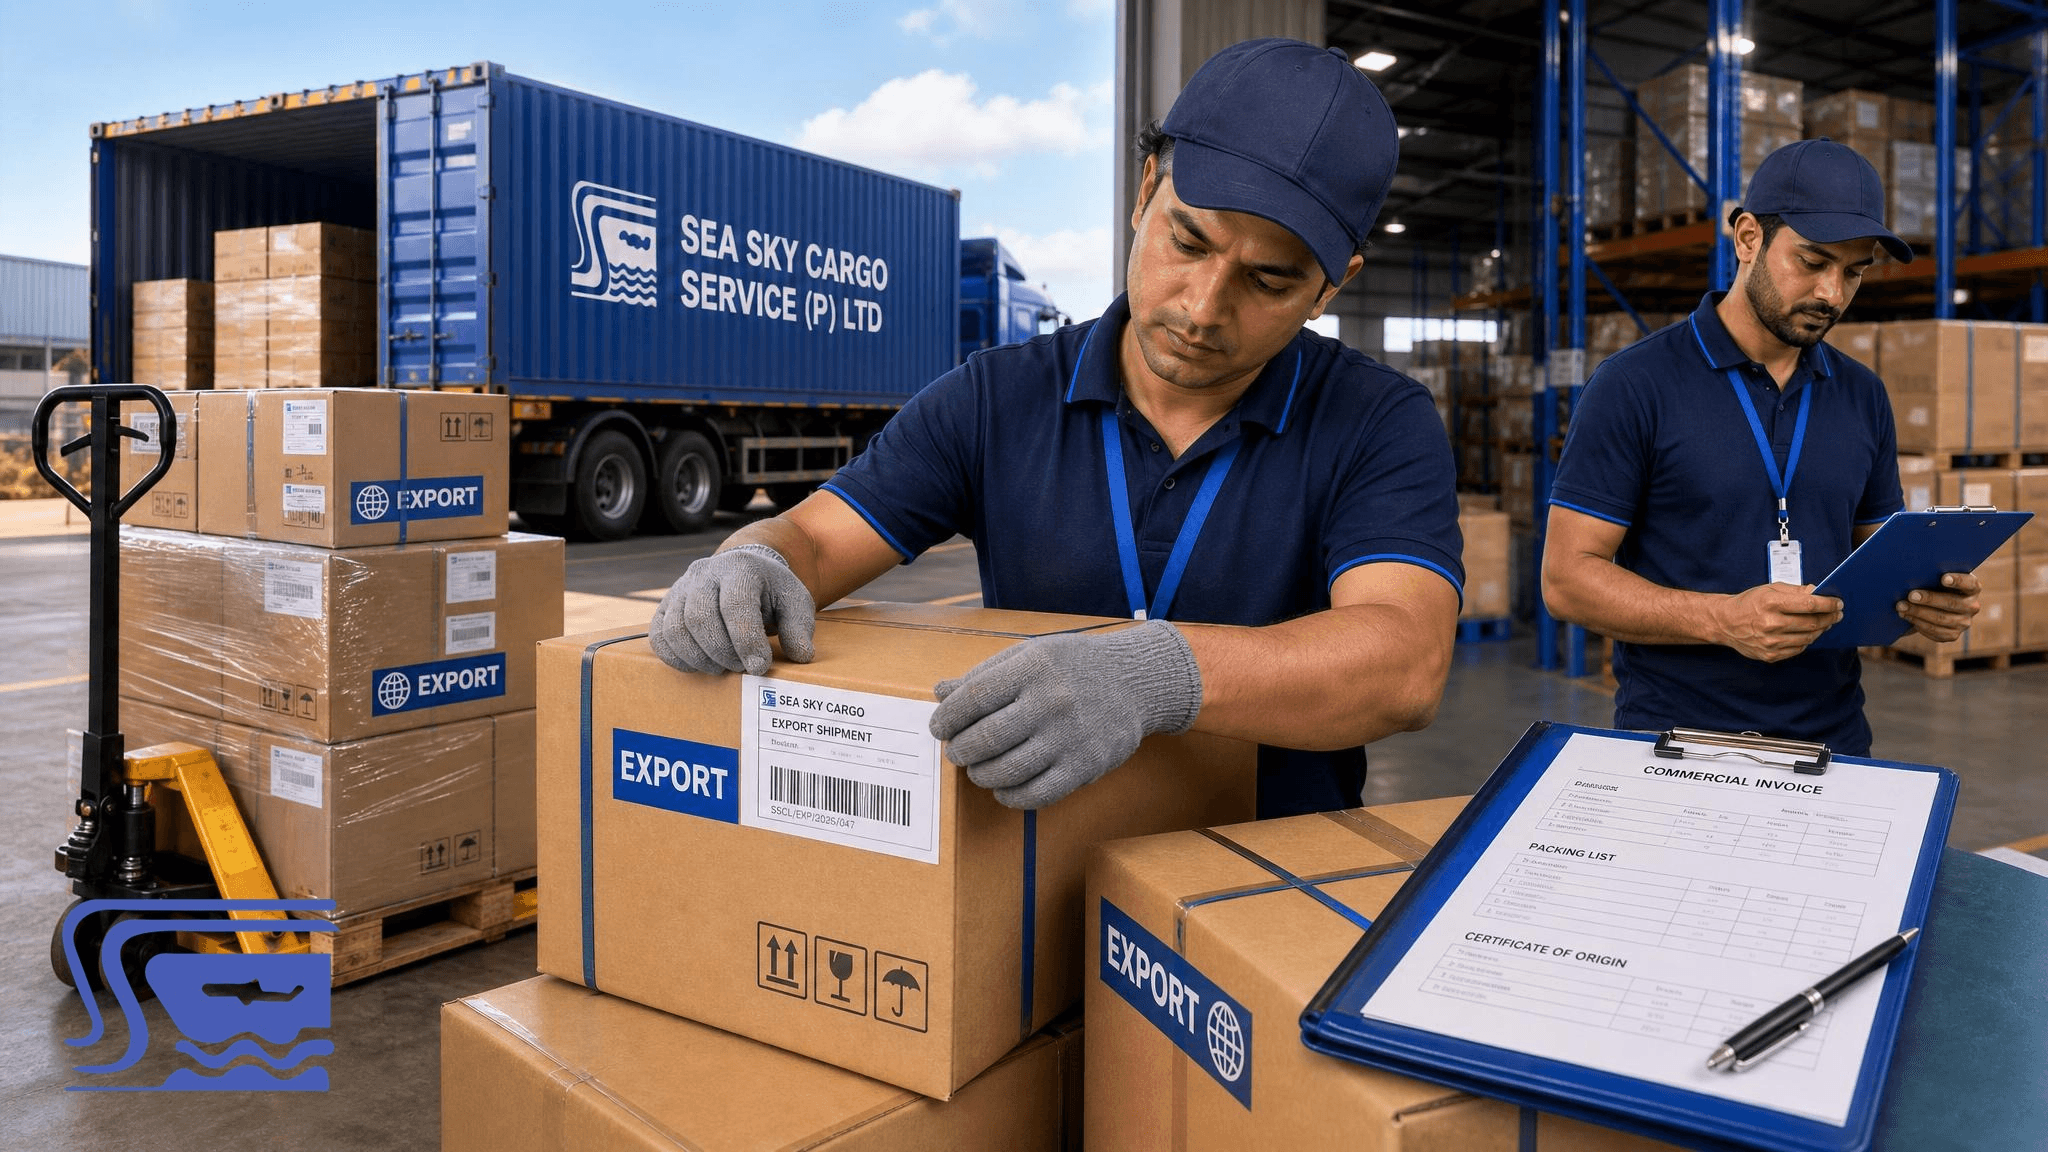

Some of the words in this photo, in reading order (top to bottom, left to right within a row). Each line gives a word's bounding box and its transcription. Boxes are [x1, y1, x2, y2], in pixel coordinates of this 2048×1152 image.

[680, 214, 739, 263] SEA
[745, 229, 799, 274] SKY
[805, 243, 889, 292] CARGO
[680, 268, 798, 322] SERVICE
[804, 290, 837, 334] (P)
[843, 298, 883, 334] LTD
[397, 486, 479, 510] EXPORT
[418, 664, 500, 697] EXPORT
[779, 695, 800, 708] SEA
[802, 698, 824, 711] SKY
[826, 702, 865, 718] CARGO
[771, 717, 814, 734] EXPORT
[816, 724, 873, 743] SHIPMENT
[620, 749, 729, 801] EXPORT
[1643, 765, 1750, 787] COMMERCIAL
[1755, 778, 1824, 795] INVOICE
[1528, 842, 1586, 858] PACKING
[1588, 851, 1616, 862] LIST
[1464, 931, 1551, 954] CERTIFICATE
[1552, 947, 1573, 958] OF
[1575, 951, 1628, 969] ORIGIN
[1107, 923, 1200, 1035] EXPORT
